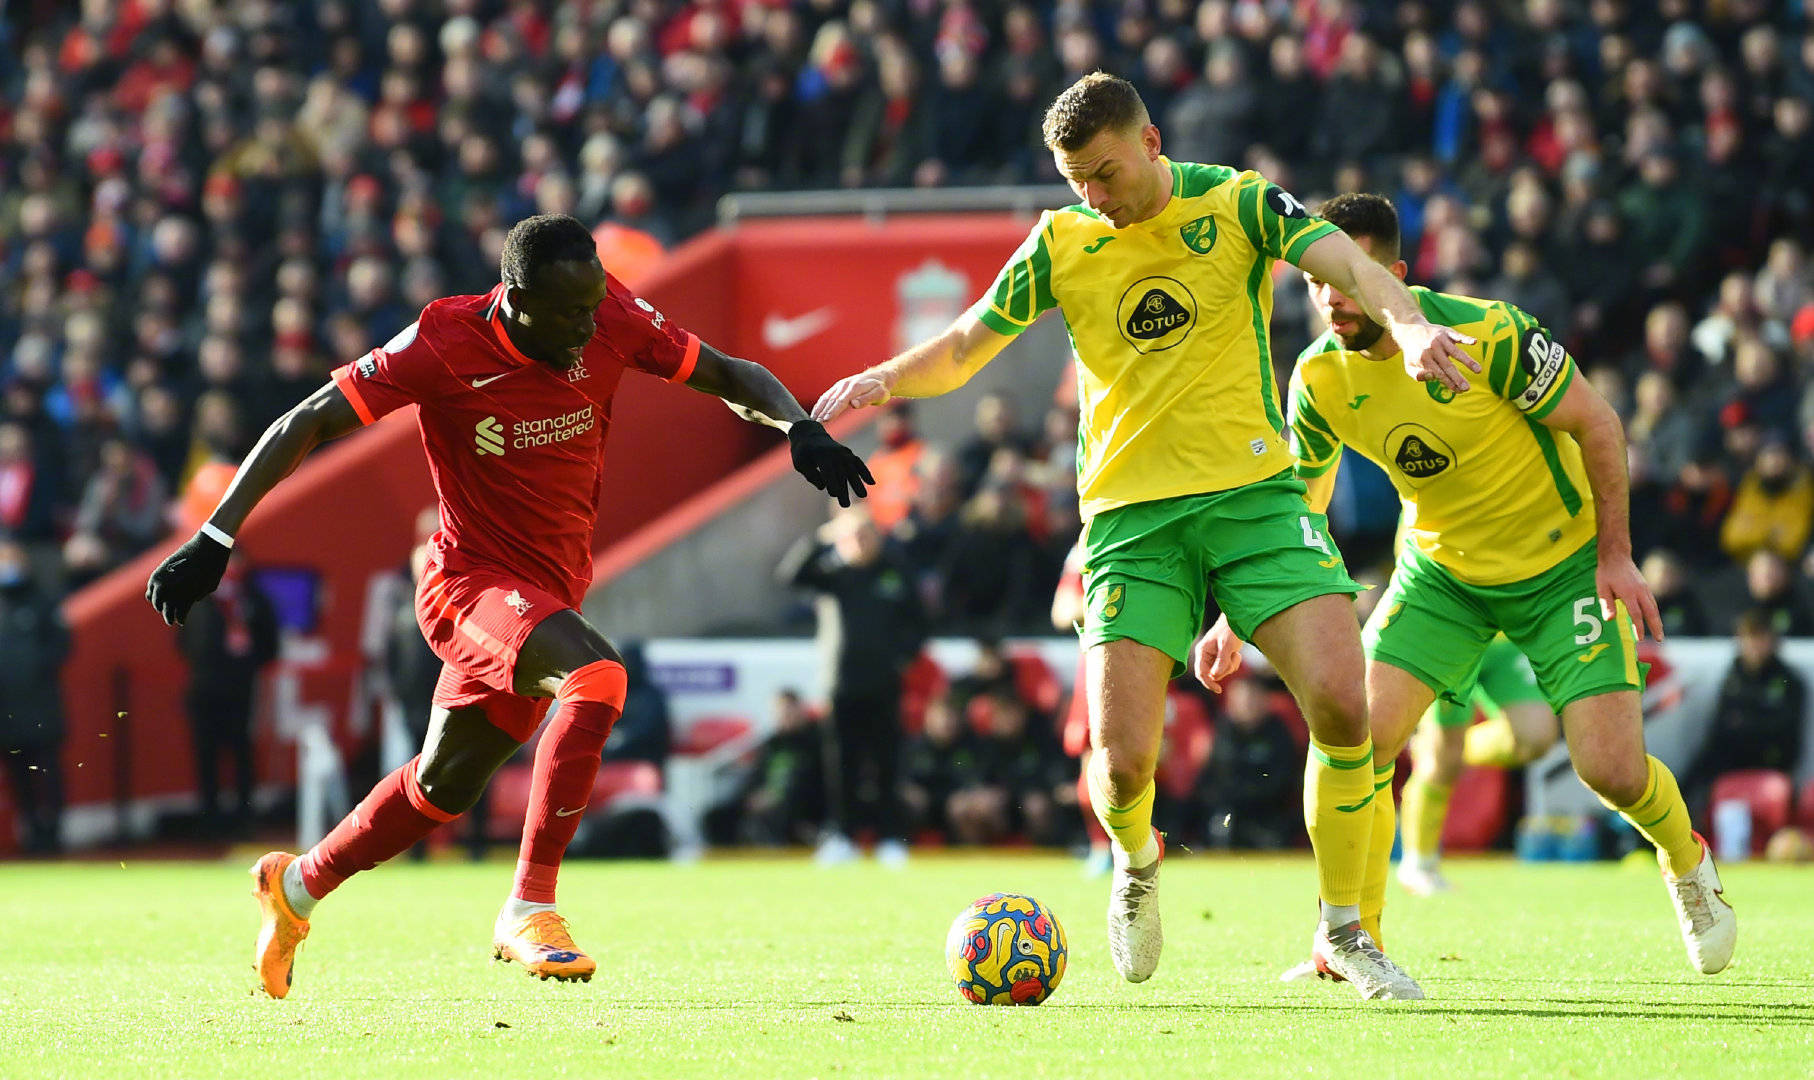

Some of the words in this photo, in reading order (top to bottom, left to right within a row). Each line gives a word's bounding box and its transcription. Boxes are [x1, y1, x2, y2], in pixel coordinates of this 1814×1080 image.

[1132, 312, 1185, 334] LOTUS
[1528, 332, 1549, 374] JD
[568, 368, 591, 382] LFC
[513, 404, 593, 435] standard
[513, 416, 595, 449] chartered
[1398, 457, 1446, 472] LOTUS
[1300, 516, 1332, 555] 4
[1573, 596, 1603, 645] 5
